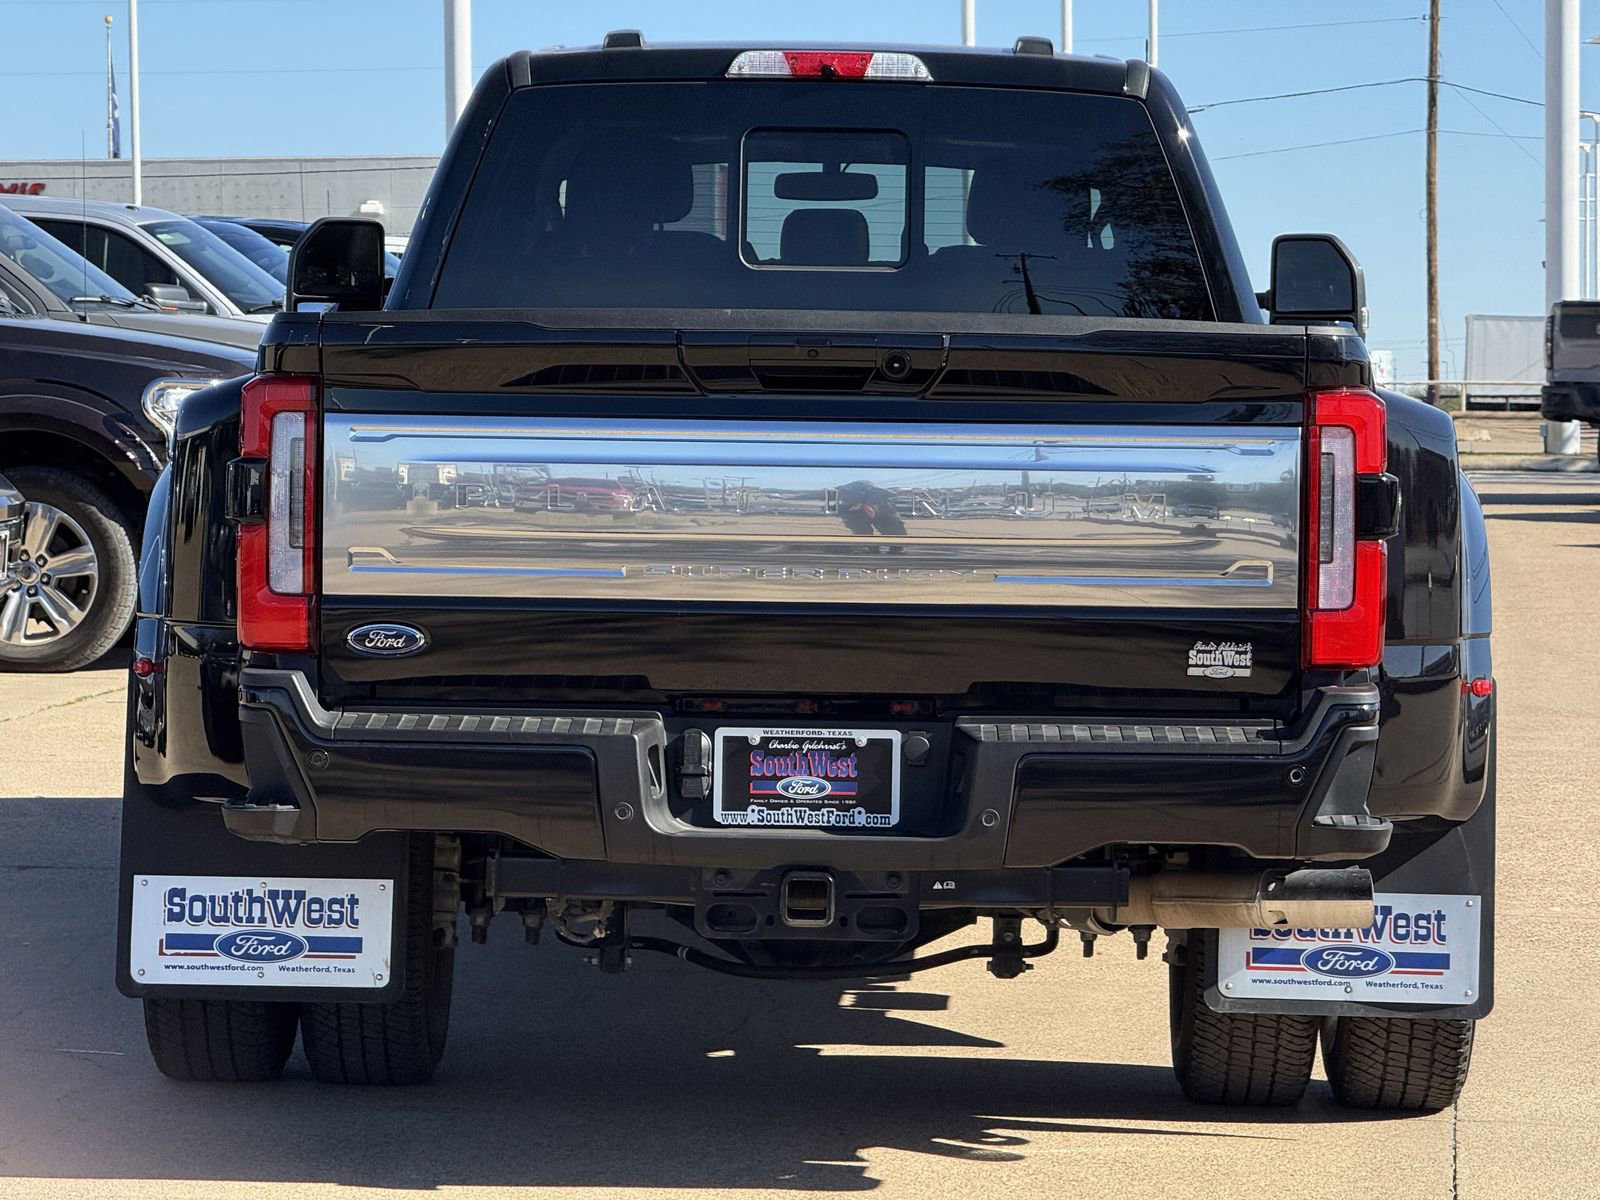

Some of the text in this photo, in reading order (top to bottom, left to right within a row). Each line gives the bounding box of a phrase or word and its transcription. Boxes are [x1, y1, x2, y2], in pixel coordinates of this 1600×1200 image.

[365, 630, 406, 648] Ford
[1189, 649, 1252, 666] SouthWest
[1209, 668, 1229, 676] Ford
[768, 739, 847, 754] Charlie Gilchrist's
[750, 750, 858, 778] SouthWest
[788, 780, 819, 795] Ford
[164, 887, 360, 929] SouthWest
[231, 935, 291, 956] Ford
[164, 963, 356, 974] www.southwestford.com Weatherford, Texas
[1317, 950, 1378, 971] Ford
[1251, 978, 1444, 990] www.southwestford.com Weatherford, Texas
